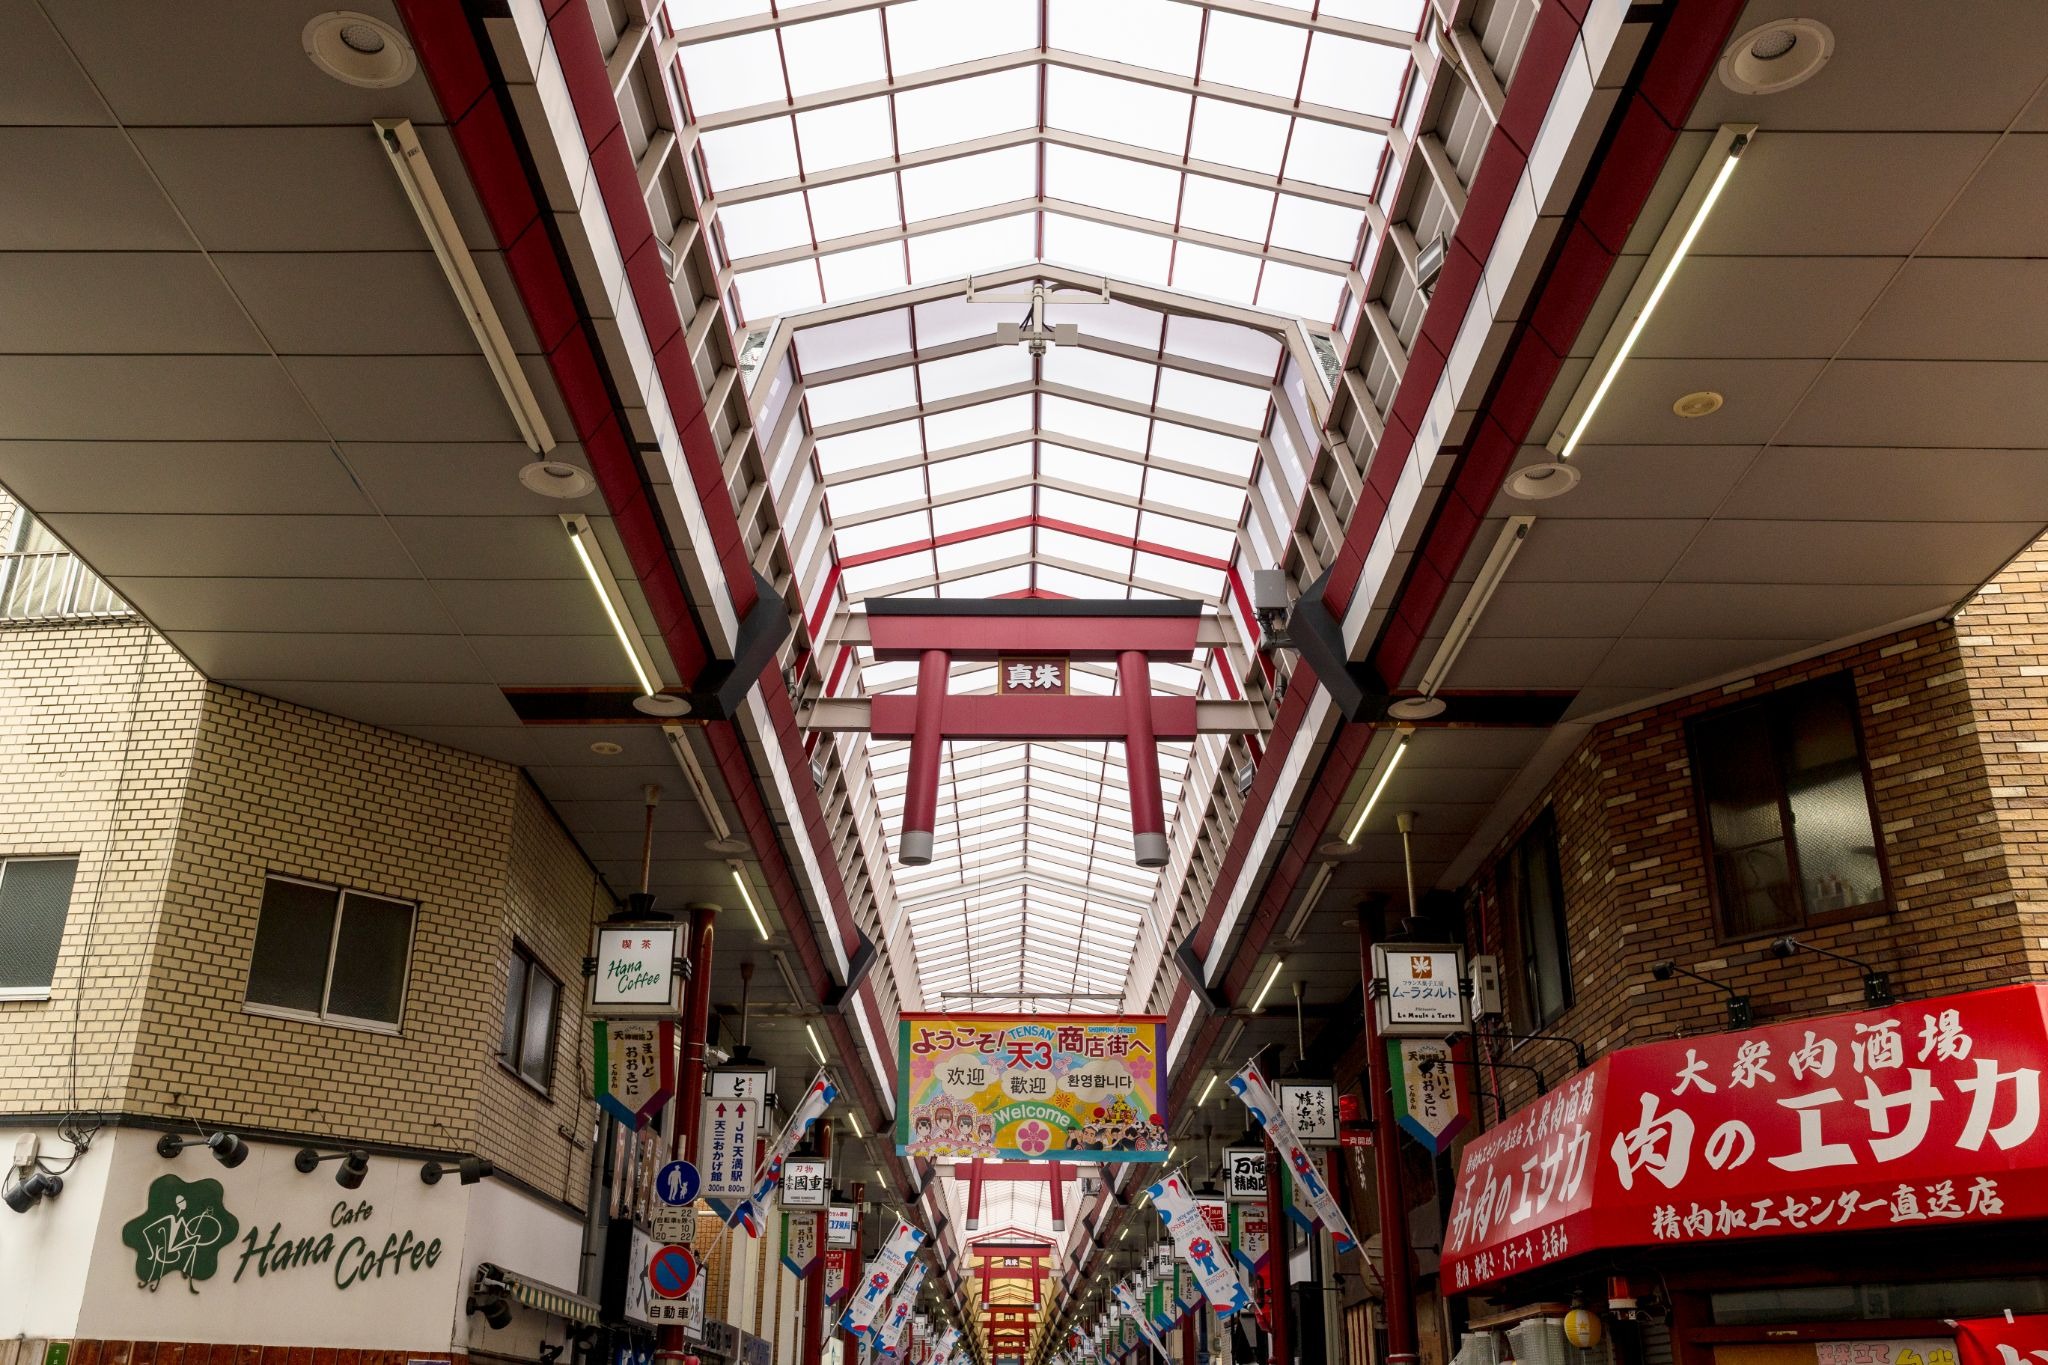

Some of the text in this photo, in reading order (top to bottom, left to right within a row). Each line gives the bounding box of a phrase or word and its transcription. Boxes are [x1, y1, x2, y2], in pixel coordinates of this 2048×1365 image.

[1007, 663, 1062, 689] 真朱
[622, 939, 651, 950] 喫茶
[607, 958, 642, 979] Hana
[618, 971, 660, 994] Coffee
[1392, 986, 1457, 999] ムーラタルト
[1007, 1025, 1054, 1041] TENSAN
[1088, 1026, 1137, 1034] SHOPPING STREET
[912, 1026, 1152, 1070] ようこそ! 天3 商店街へ
[1671, 1008, 1973, 1096] 大衆肉酒場
[625, 1046, 639, 1095] おおきに
[641, 1042, 654, 1078] まいど
[947, 1066, 1047, 1095] 欢迎 歡迎
[1067, 1074, 1133, 1089] 환영합니다
[1437, 1063, 1451, 1100] まいど
[995, 1102, 1072, 1128] Welcome
[1523, 1071, 1595, 1148] 大衆肉酒場
[1610, 1058, 2042, 1192] 肉のエサカ
[710, 1120, 726, 1182] 天三おかげ館
[795, 1165, 813, 1173] 刃物
[708, 1184, 725, 1193] 300m
[727, 1184, 745, 1193] 800m
[786, 1174, 795, 1191] 本家
[795, 1174, 823, 1191] 國重
[1471, 1123, 1592, 1244] 肉のエサカ
[331, 1200, 373, 1228] Cafe
[658, 1209, 664, 1217] 7
[681, 1209, 692, 1217] 22
[1652, 1176, 2004, 1241] 精肉加工センター直送店
[655, 1232, 666, 1241] 20
[680, 1233, 691, 1241] 22
[658, 1224, 664, 1232] 7
[681, 1224, 690, 1233] 10
[797, 1228, 805, 1259] おおきに
[233, 1222, 443, 1290] Hana Coffee
[886, 1254, 894, 1262] the
[893, 1259, 905, 1269] EXPO
[892, 1251, 901, 1260] you
[650, 1305, 689, 1320] 自動車
